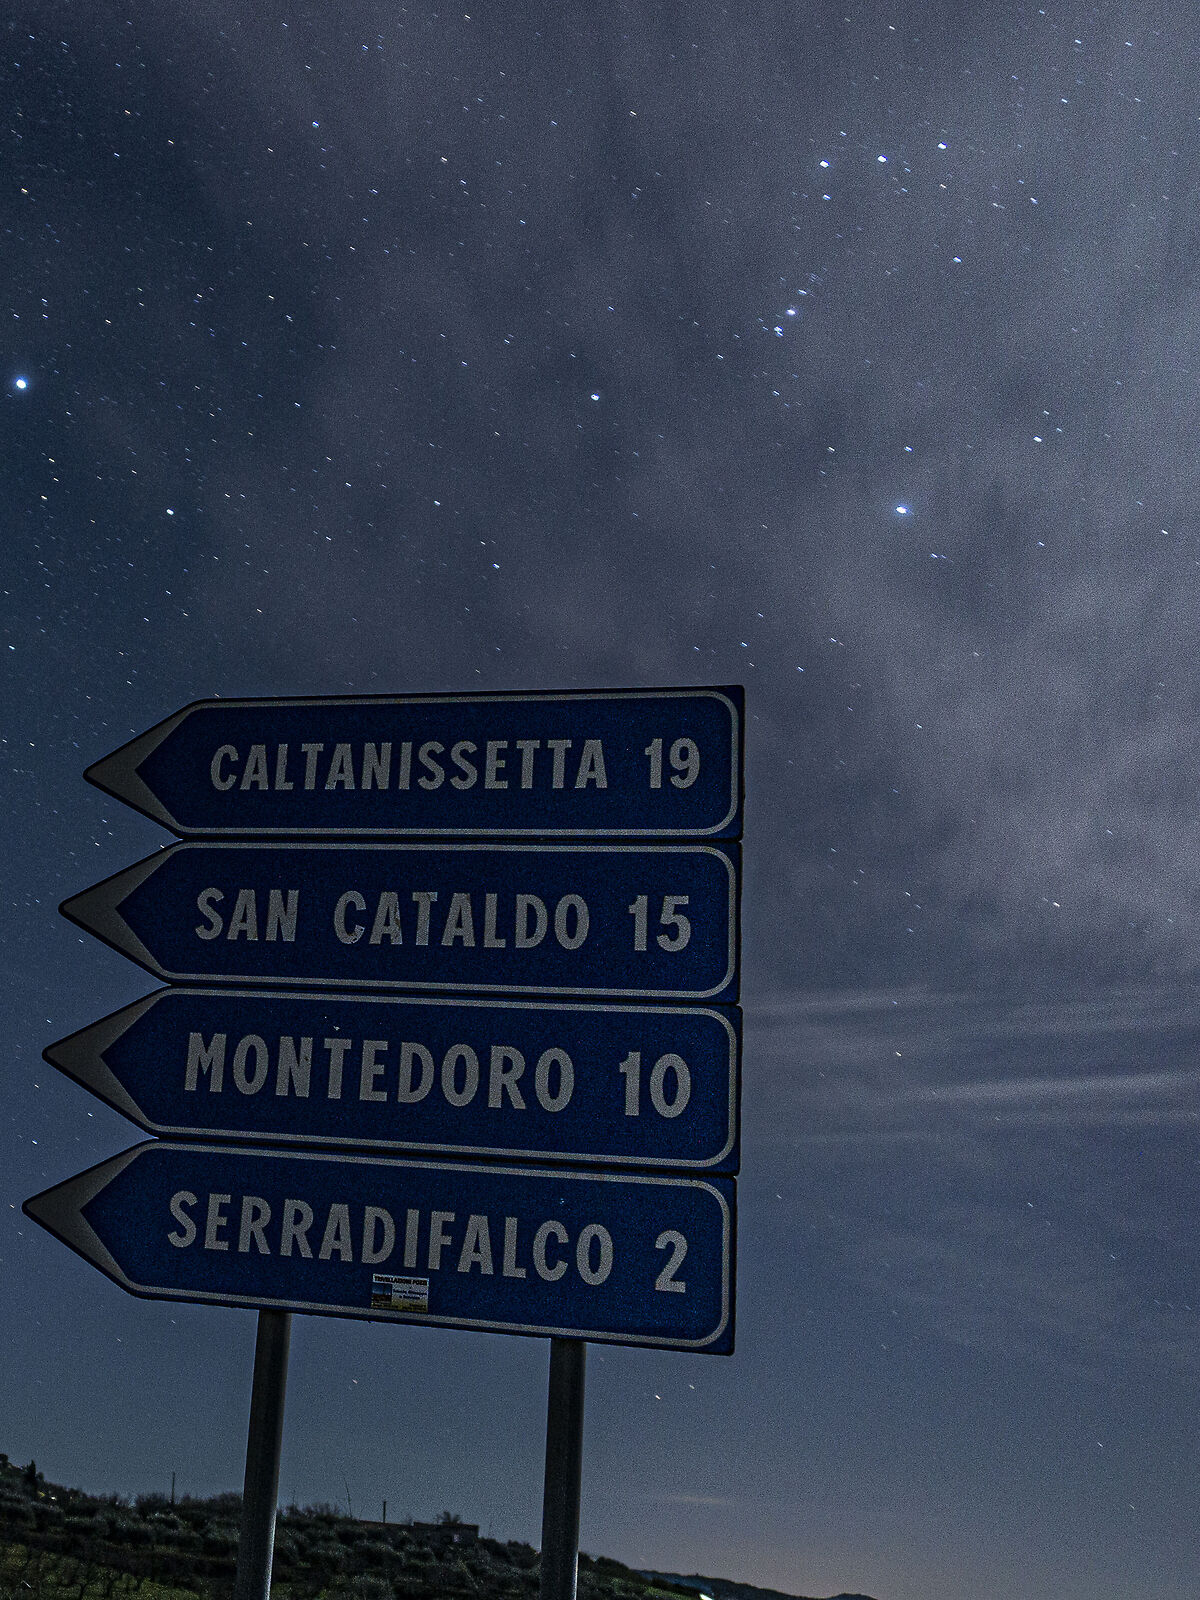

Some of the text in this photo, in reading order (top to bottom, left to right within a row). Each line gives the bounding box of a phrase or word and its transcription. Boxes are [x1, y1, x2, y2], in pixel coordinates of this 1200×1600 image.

[209, 738, 700, 791] CALTANISSETTA 19
[195, 888, 692, 952] SAN CATALDO 15
[184, 1032, 692, 1118] MONTEDORO 10
[167, 1191, 689, 1293] SERRADIFALCO 2
